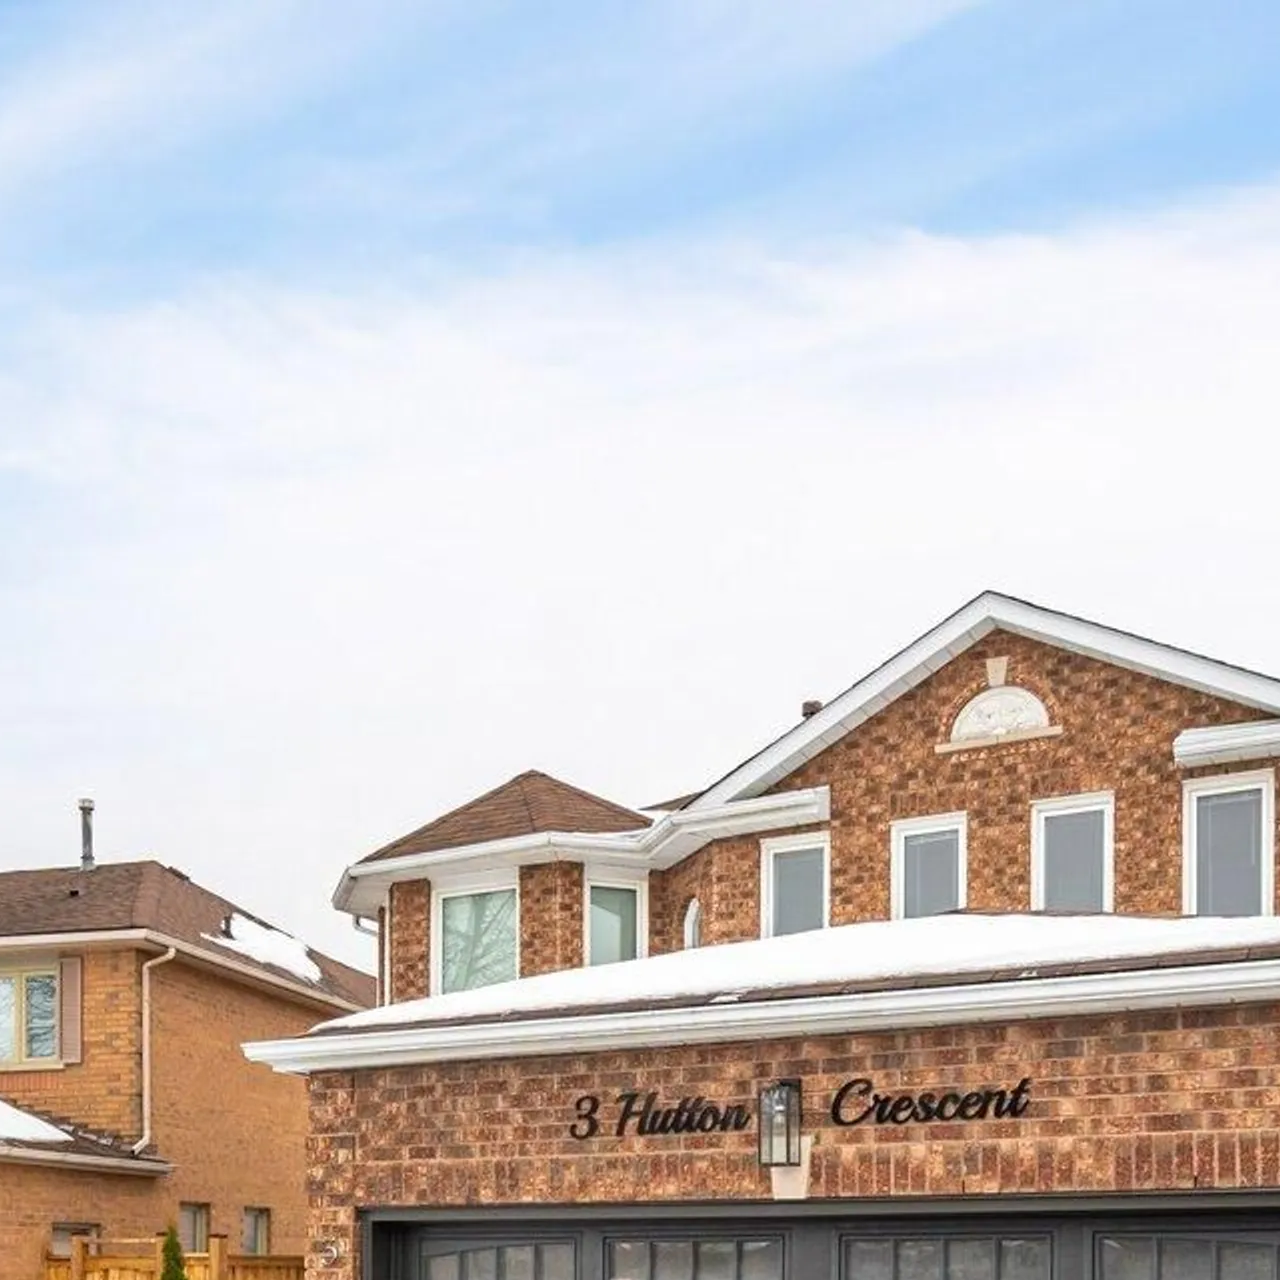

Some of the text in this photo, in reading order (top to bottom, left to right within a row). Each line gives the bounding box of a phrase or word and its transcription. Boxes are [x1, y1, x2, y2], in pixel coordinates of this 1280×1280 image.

[570, 1077, 1033, 1139] 3 Hutton Crescent
